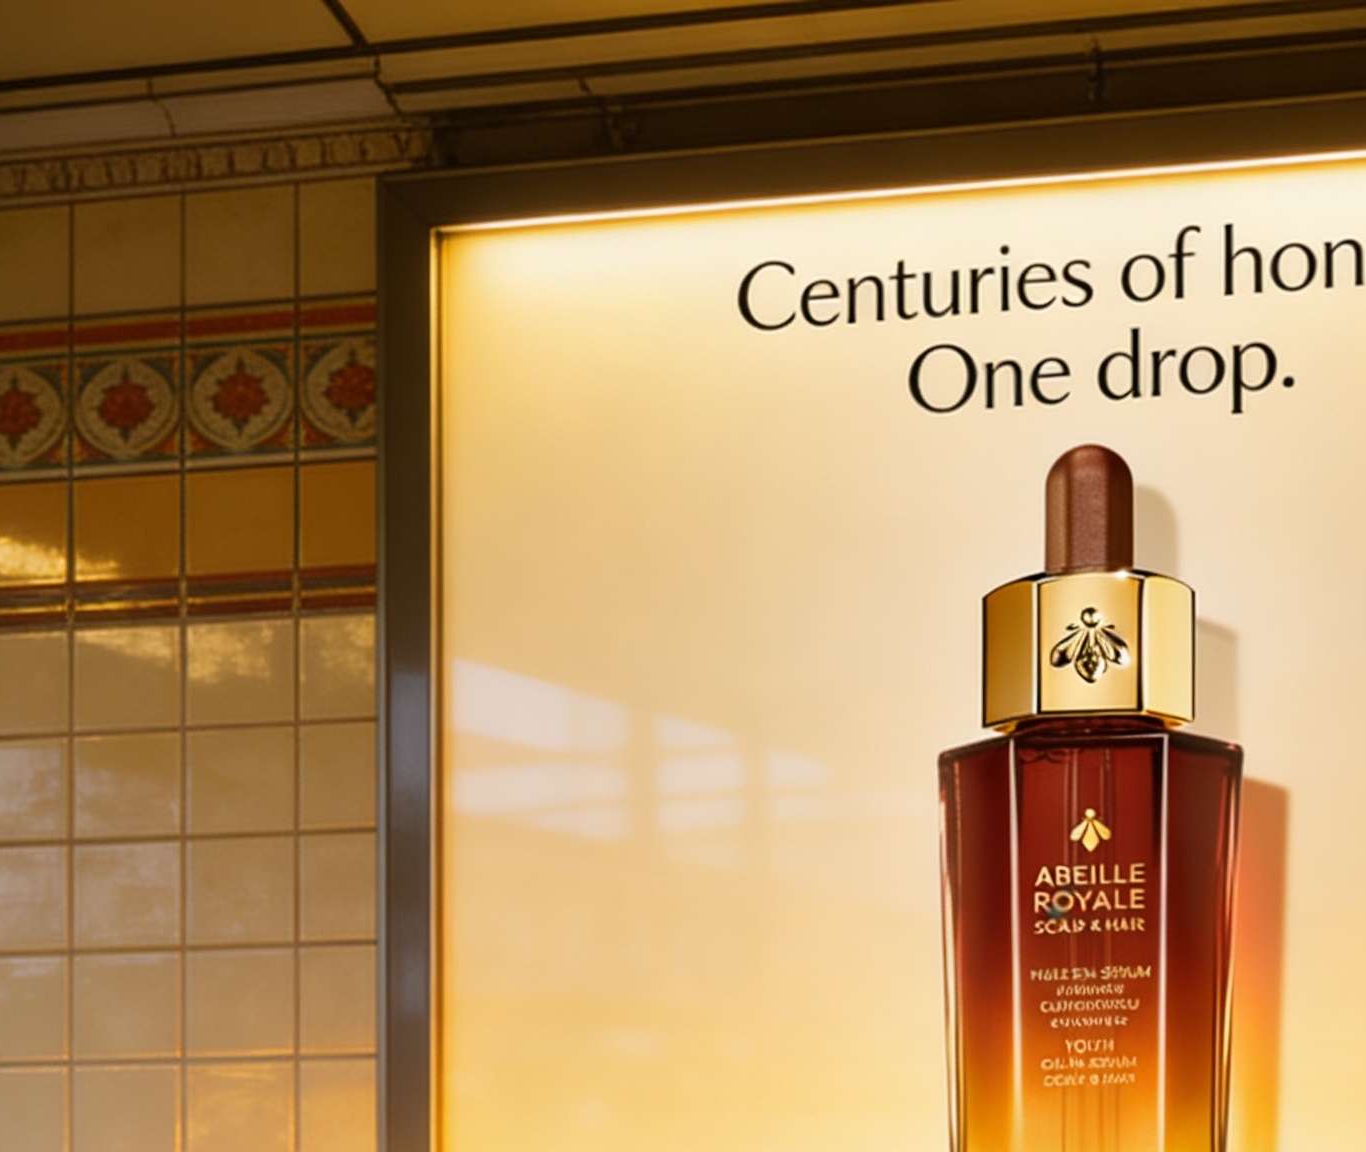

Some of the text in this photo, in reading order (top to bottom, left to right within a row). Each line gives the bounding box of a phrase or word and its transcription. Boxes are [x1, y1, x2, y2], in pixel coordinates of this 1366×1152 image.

[737, 244, 1094, 331] Centuries
[1120, 224, 1202, 304] of
[907, 327, 1295, 415] One drop.
[1034, 862, 1146, 887] ABEILLE
[1033, 888, 1146, 914] ROYALE
[1105, 917, 1146, 932] HAIR
